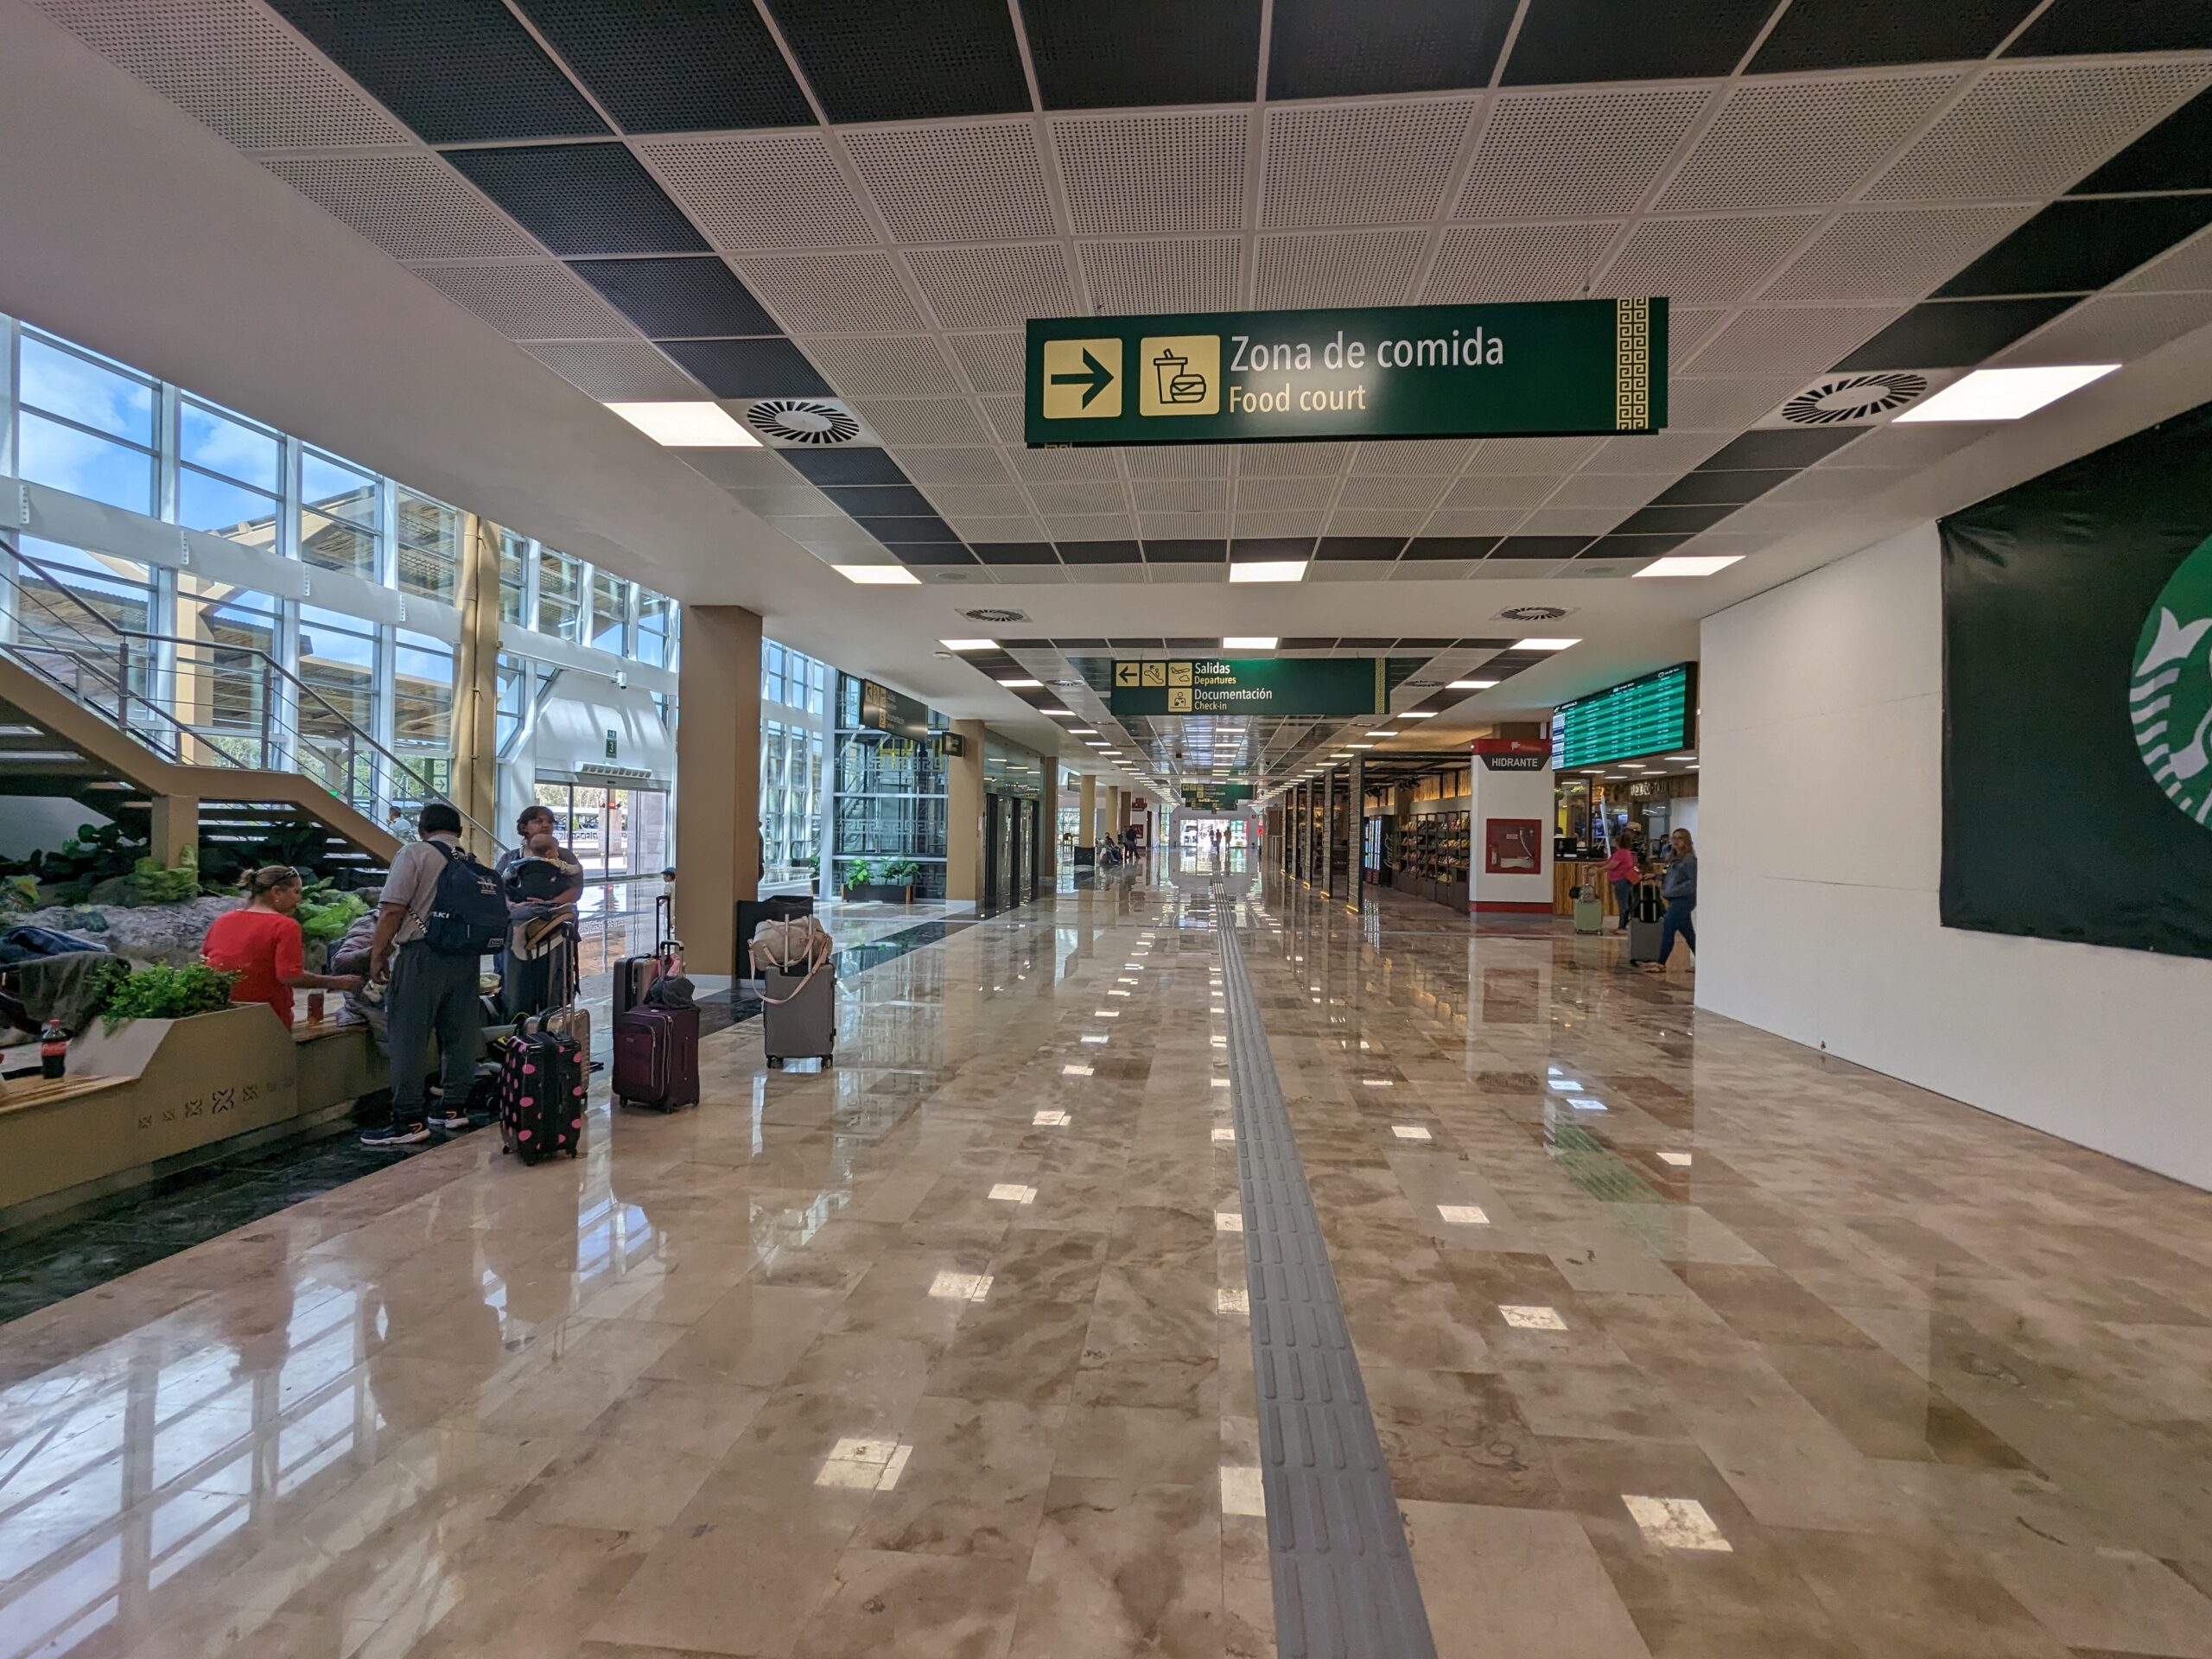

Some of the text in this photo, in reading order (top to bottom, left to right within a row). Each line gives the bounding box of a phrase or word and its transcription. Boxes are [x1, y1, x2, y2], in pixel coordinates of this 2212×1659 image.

[1230, 326, 1503, 372] Zona de comida
[1230, 383, 1366, 413] Food court
[1195, 662, 1230, 675] Salidas
[1194, 676, 1236, 687] Departures
[1194, 688, 1273, 700] Documentación
[1194, 701, 1227, 710] Check-in
[609, 741, 614, 753] 3
[1491, 757, 1538, 767] HIDRANTE
